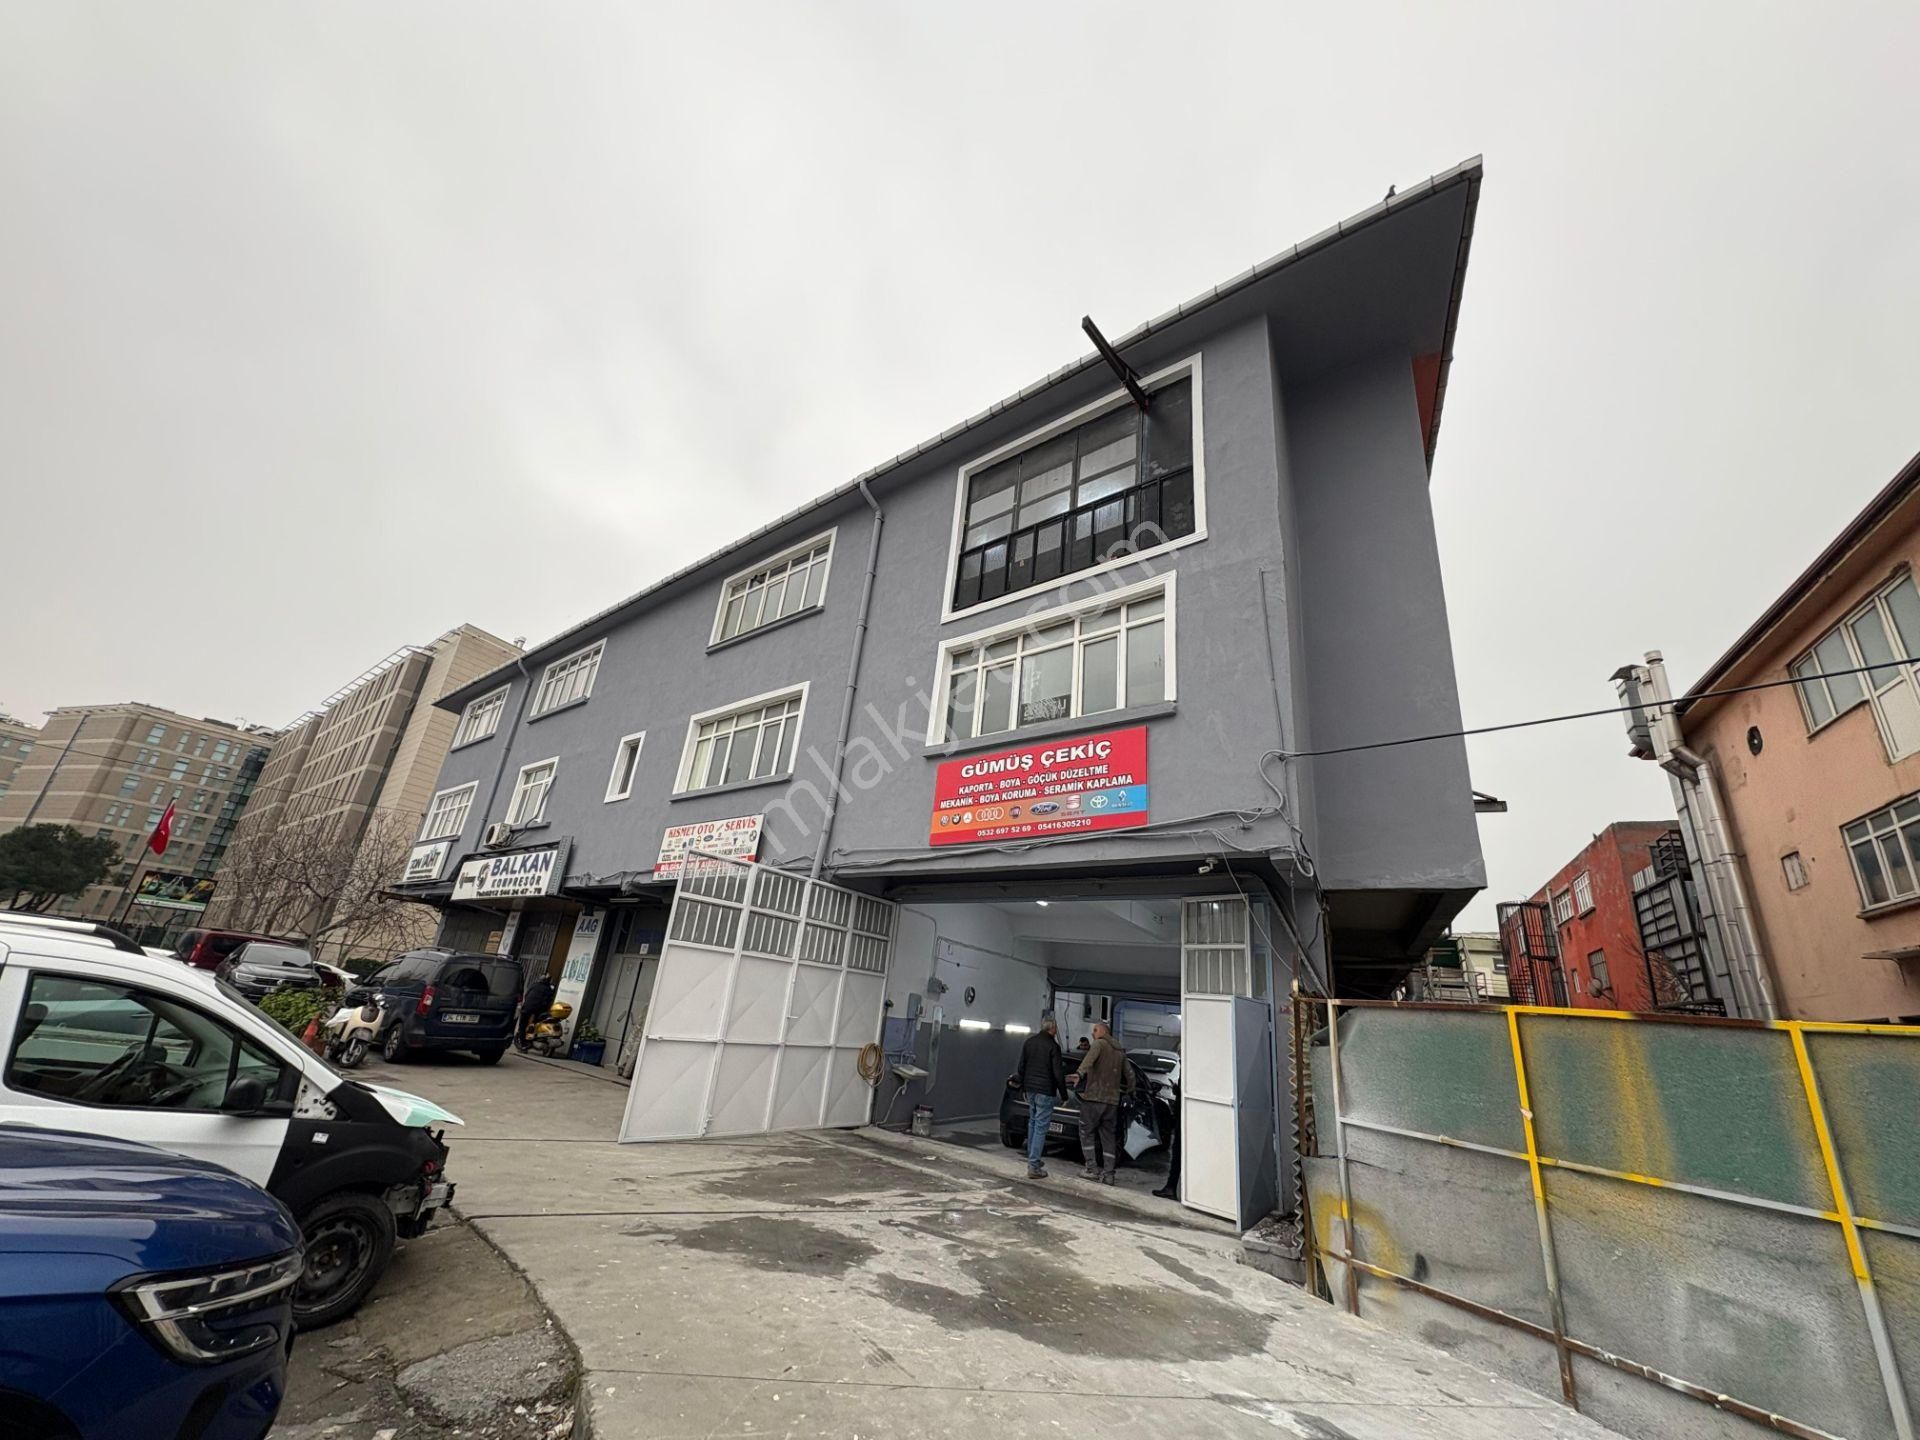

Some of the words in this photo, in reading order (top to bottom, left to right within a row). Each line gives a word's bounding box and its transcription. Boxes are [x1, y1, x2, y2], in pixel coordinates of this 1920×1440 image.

[961, 754, 1033, 778] GÜMÜŞ
[1040, 740, 1112, 766] ÇEKİÇ
[940, 796, 973, 809] MEKANİK
[979, 793, 1000, 805] BOYA
[1001, 788, 1037, 801] KORUMA
[1044, 781, 1084, 796] SERAMİK
[1086, 774, 1133, 790] KAPLAMA
[958, 782, 994, 795] KAPORTA
[1000, 778, 1021, 789] BOYA
[1027, 771, 1058, 787] GÖÇÜK
[1060, 764, 1109, 780] DÜZELTME
[697, 824, 715, 834] OTO
[724, 818, 757, 831] SERVİS
[977, 828, 994, 837] 0532
[490, 852, 553, 876] BALKAN
[577, 918, 599, 933] AAG
